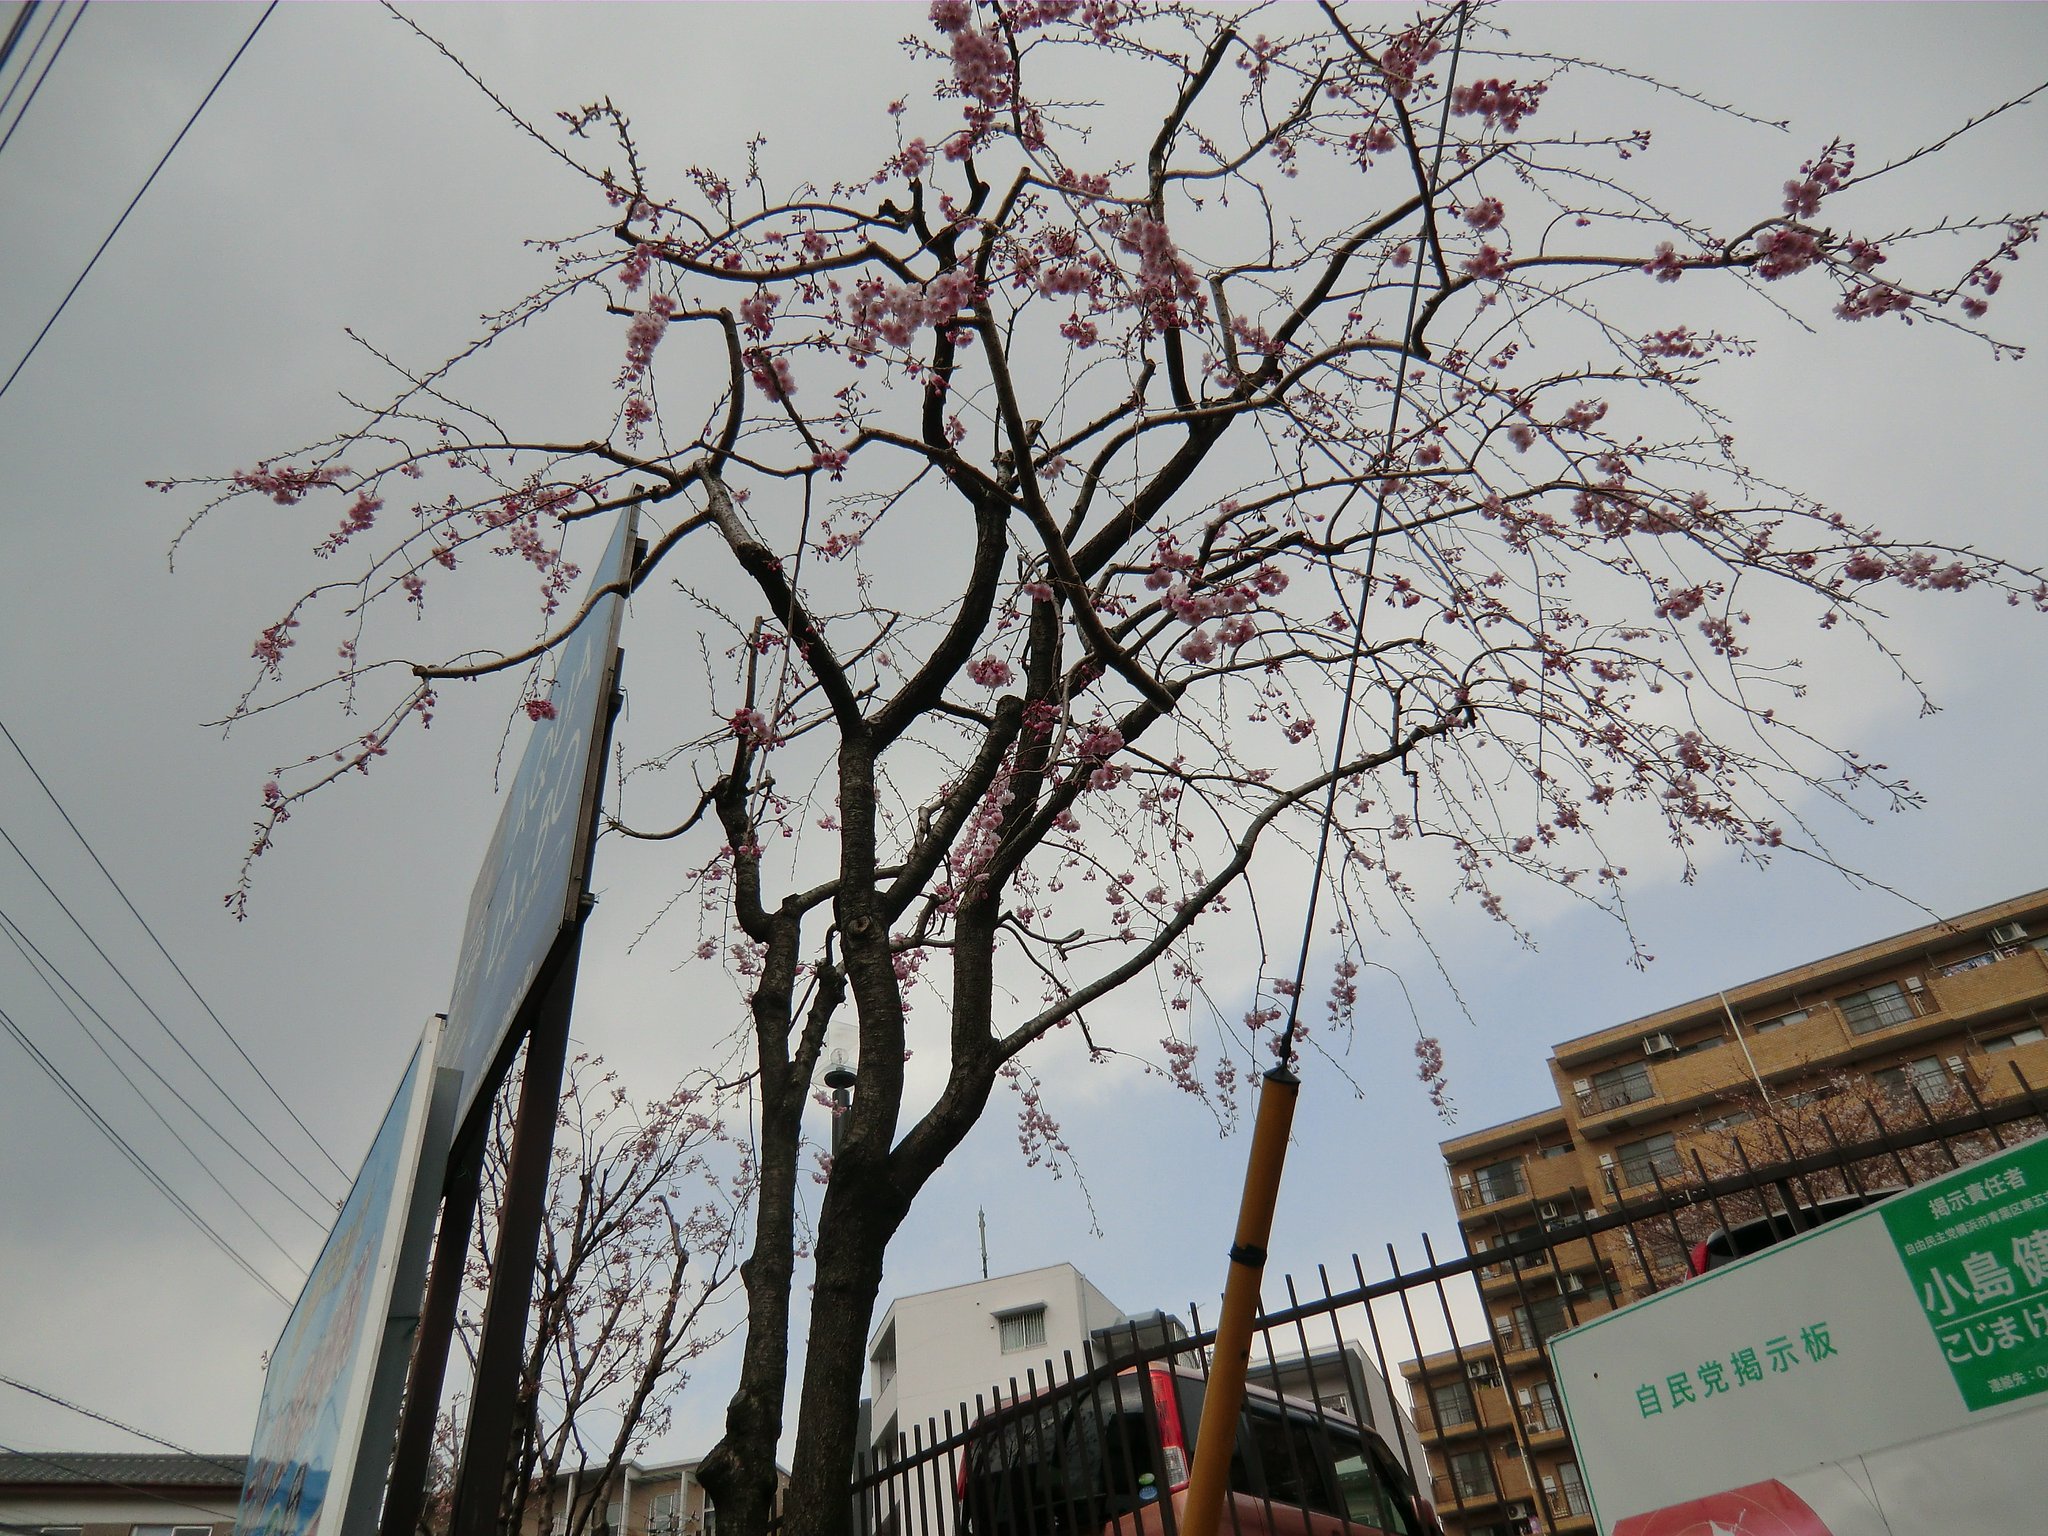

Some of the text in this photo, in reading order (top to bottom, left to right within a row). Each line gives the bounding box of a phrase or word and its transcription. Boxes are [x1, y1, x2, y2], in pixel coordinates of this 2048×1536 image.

[507, 634, 592, 868] AQUA
[1928, 1166, 2027, 1220] 掲示責任者
[1635, 1321, 1838, 1419] 自民党掲示板
